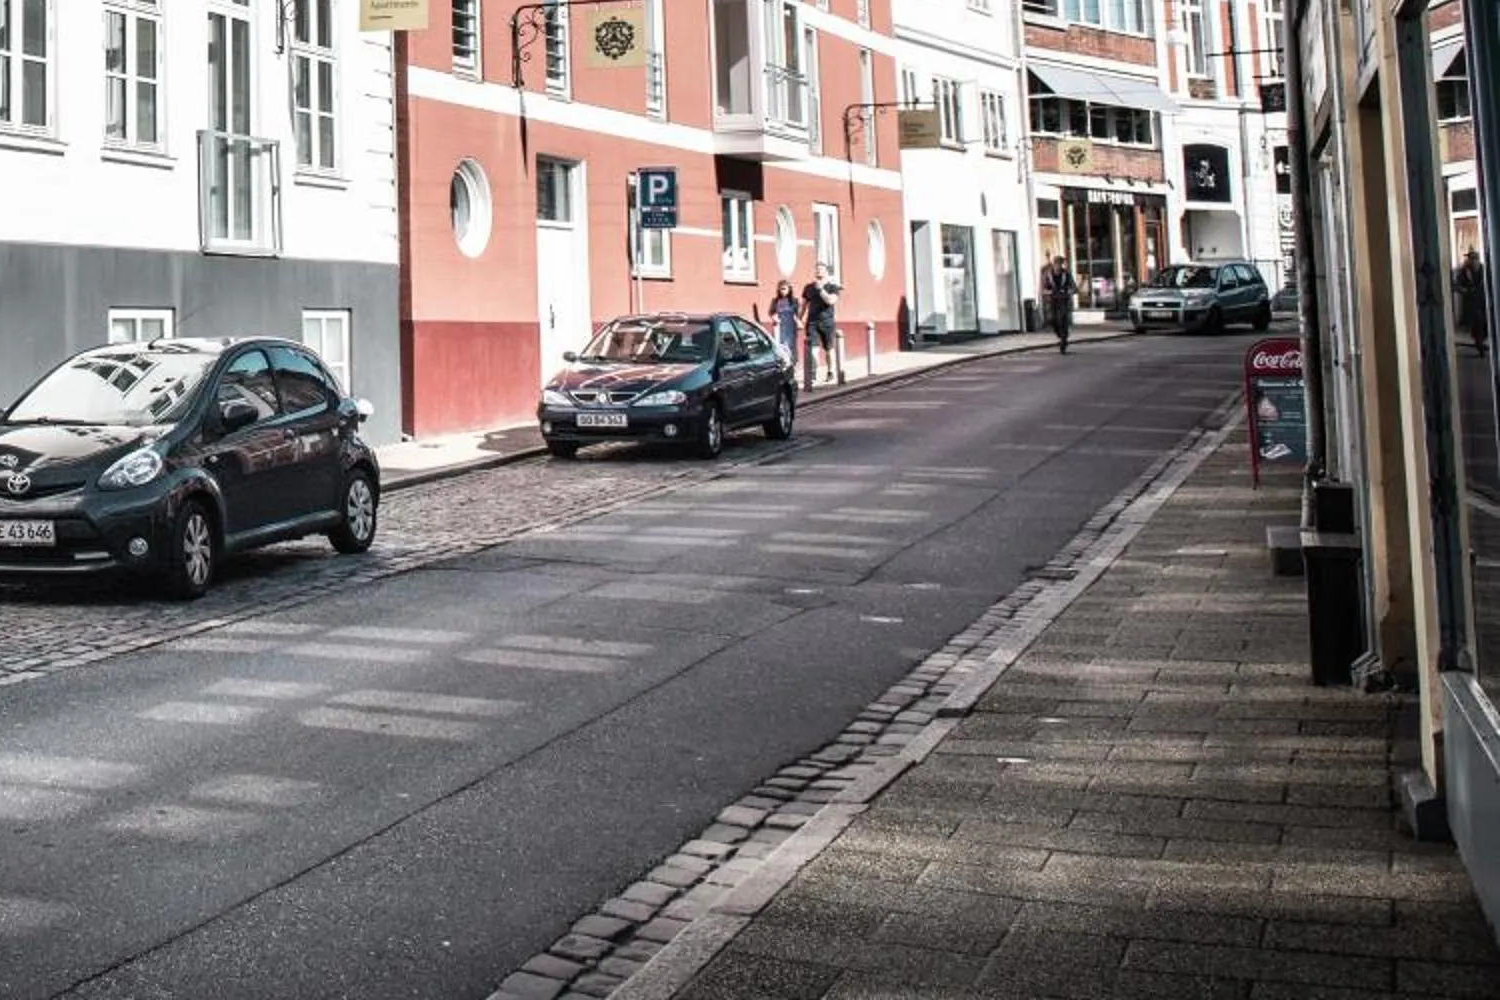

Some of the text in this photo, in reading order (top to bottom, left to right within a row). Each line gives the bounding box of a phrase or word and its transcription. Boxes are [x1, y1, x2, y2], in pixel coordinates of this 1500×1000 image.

[649, 175, 669, 204] P
[8, 523, 25, 539] 43
[27, 523, 53, 539] 646
